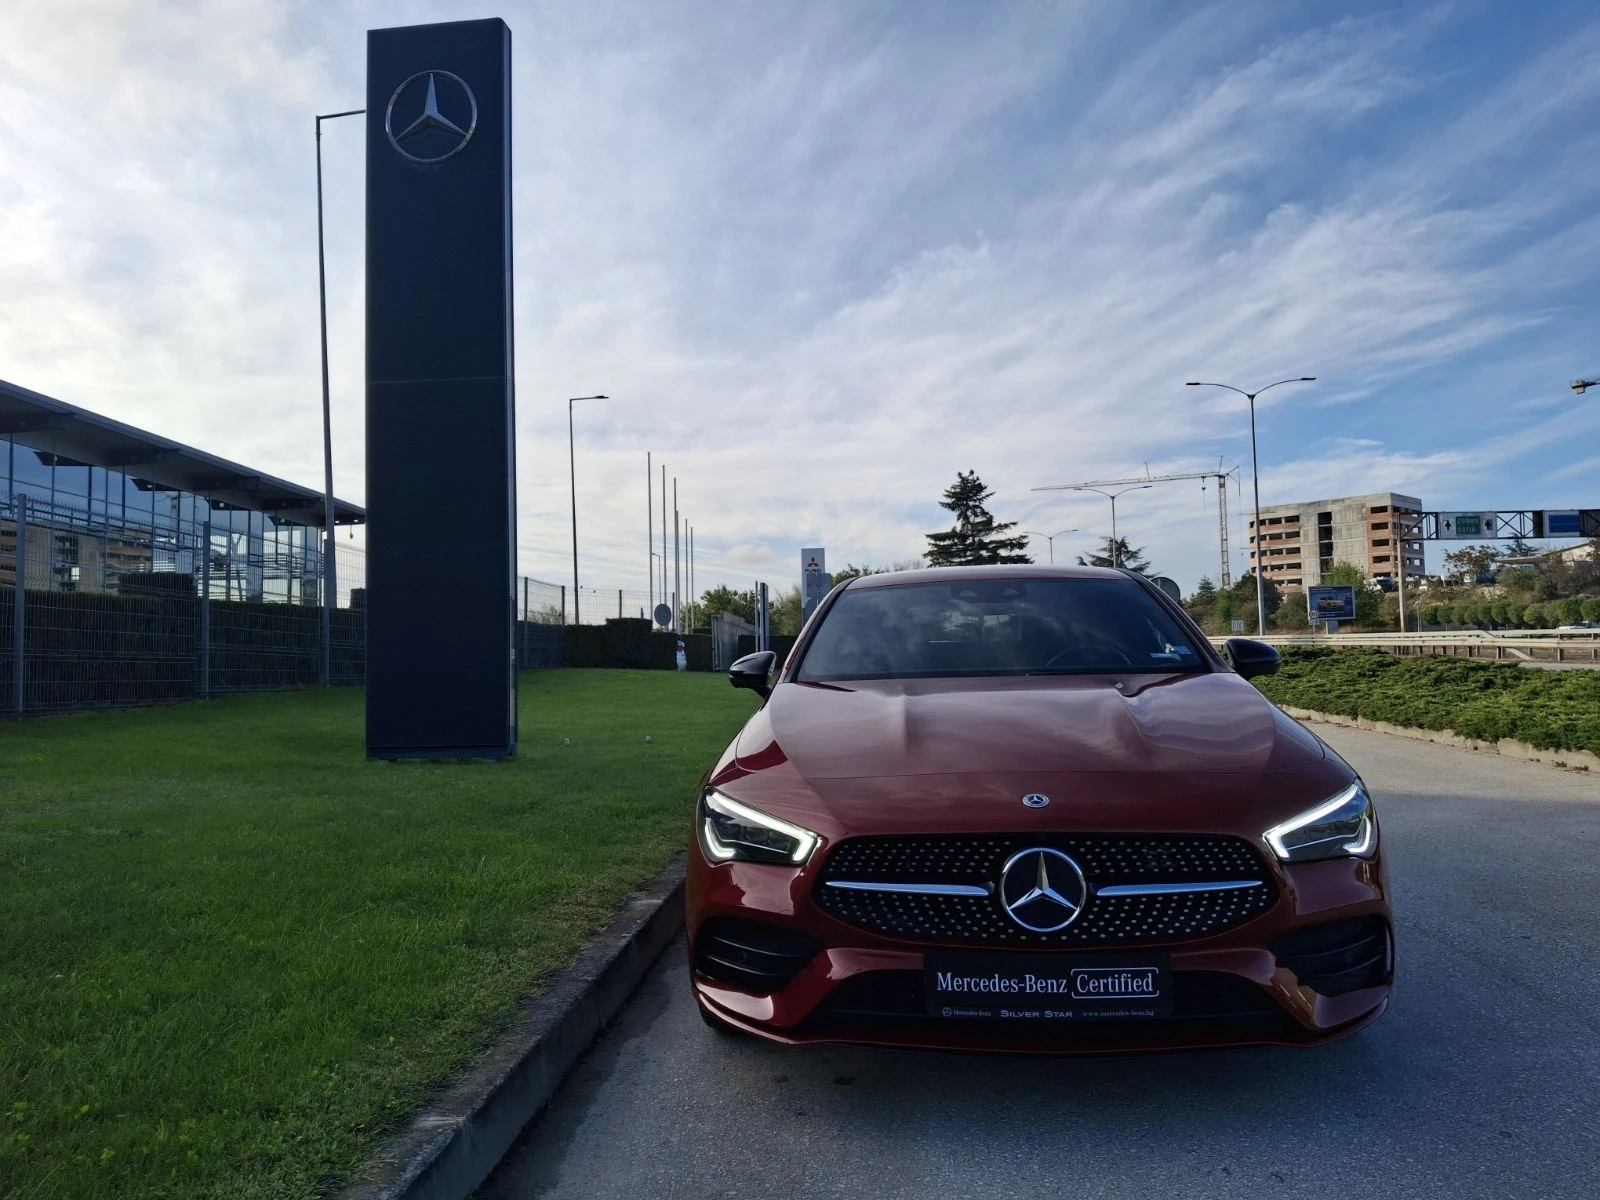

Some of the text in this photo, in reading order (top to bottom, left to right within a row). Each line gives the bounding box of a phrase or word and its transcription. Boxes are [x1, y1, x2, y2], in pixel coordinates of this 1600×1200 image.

[936, 972, 1154, 993] Mercedes-Benz Certified
[1000, 1009, 1073, 1018] SILVER STAR
